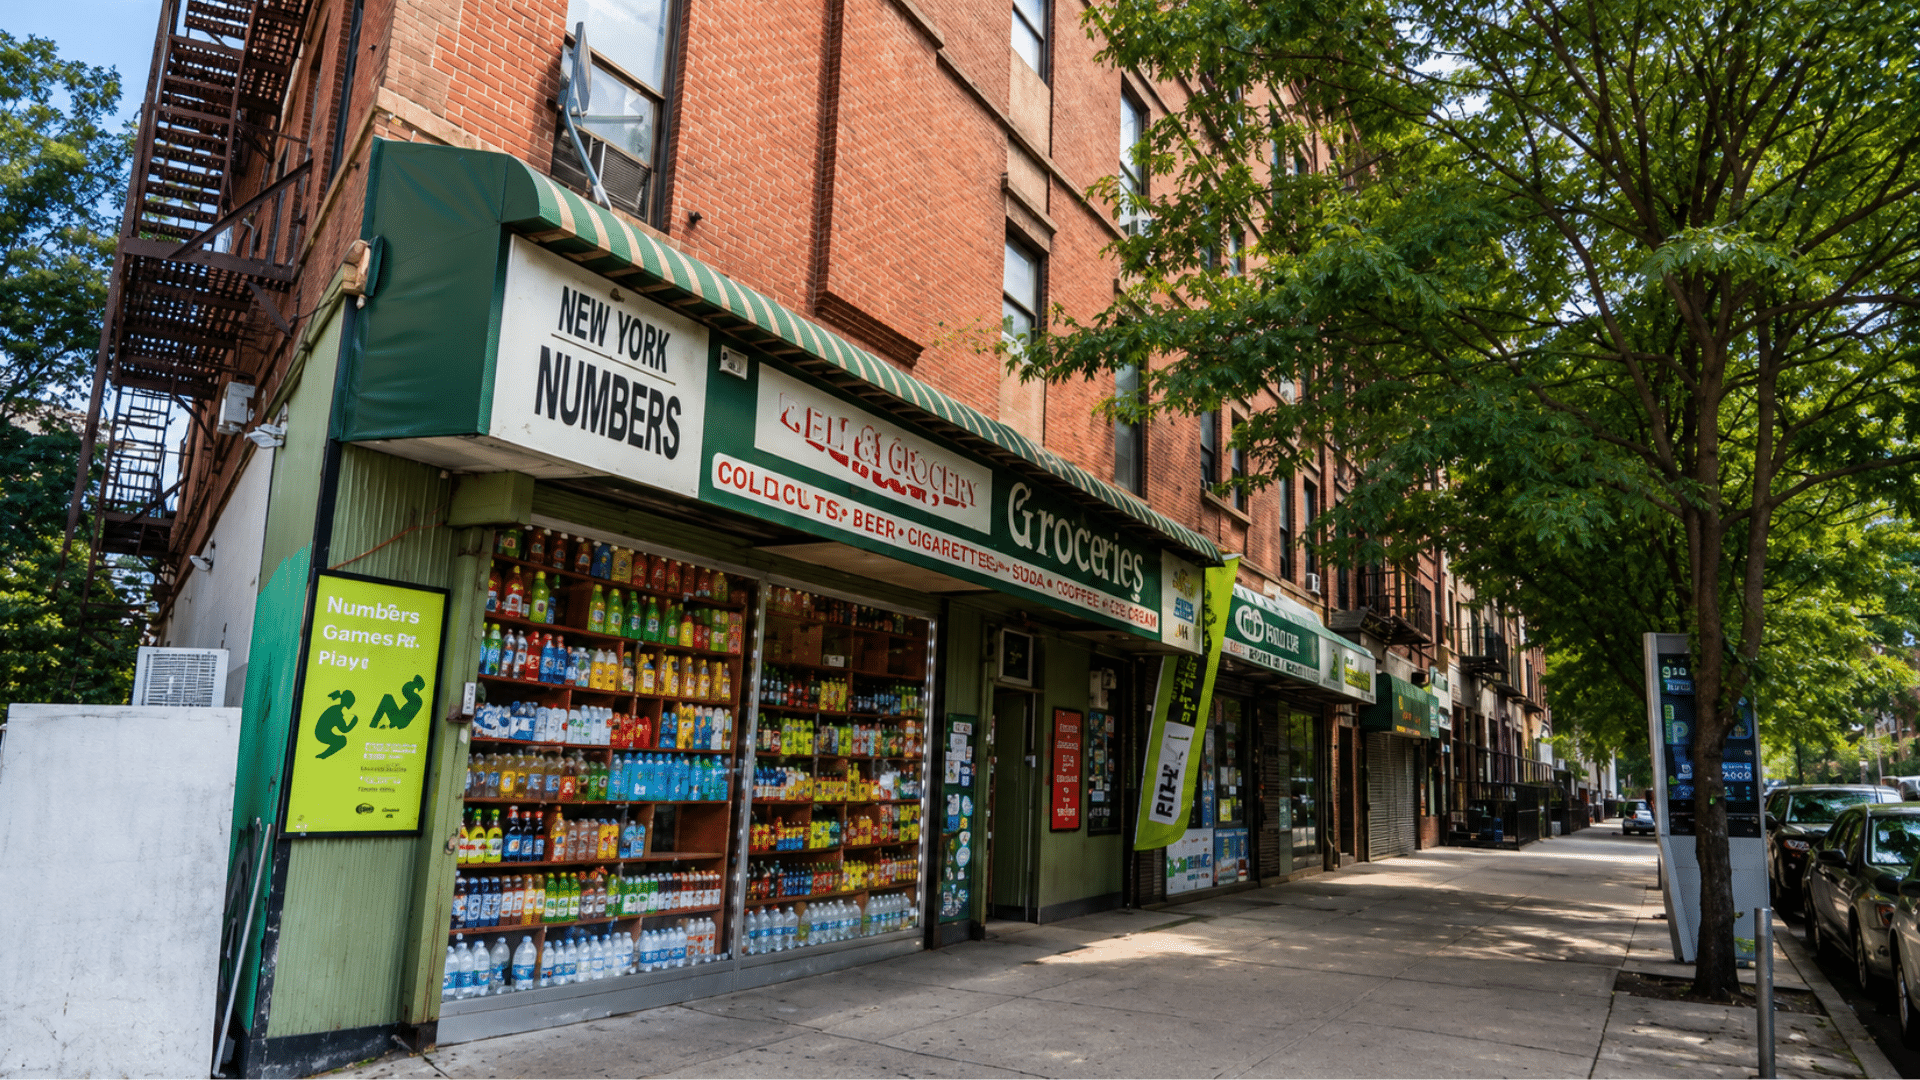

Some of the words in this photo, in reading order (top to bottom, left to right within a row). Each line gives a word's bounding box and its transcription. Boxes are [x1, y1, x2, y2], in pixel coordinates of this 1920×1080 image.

[558, 285, 610, 347] NEW
[618, 310, 671, 373] YORK
[534, 345, 682, 460] NUMBERS
[323, 624, 394, 647] Games
